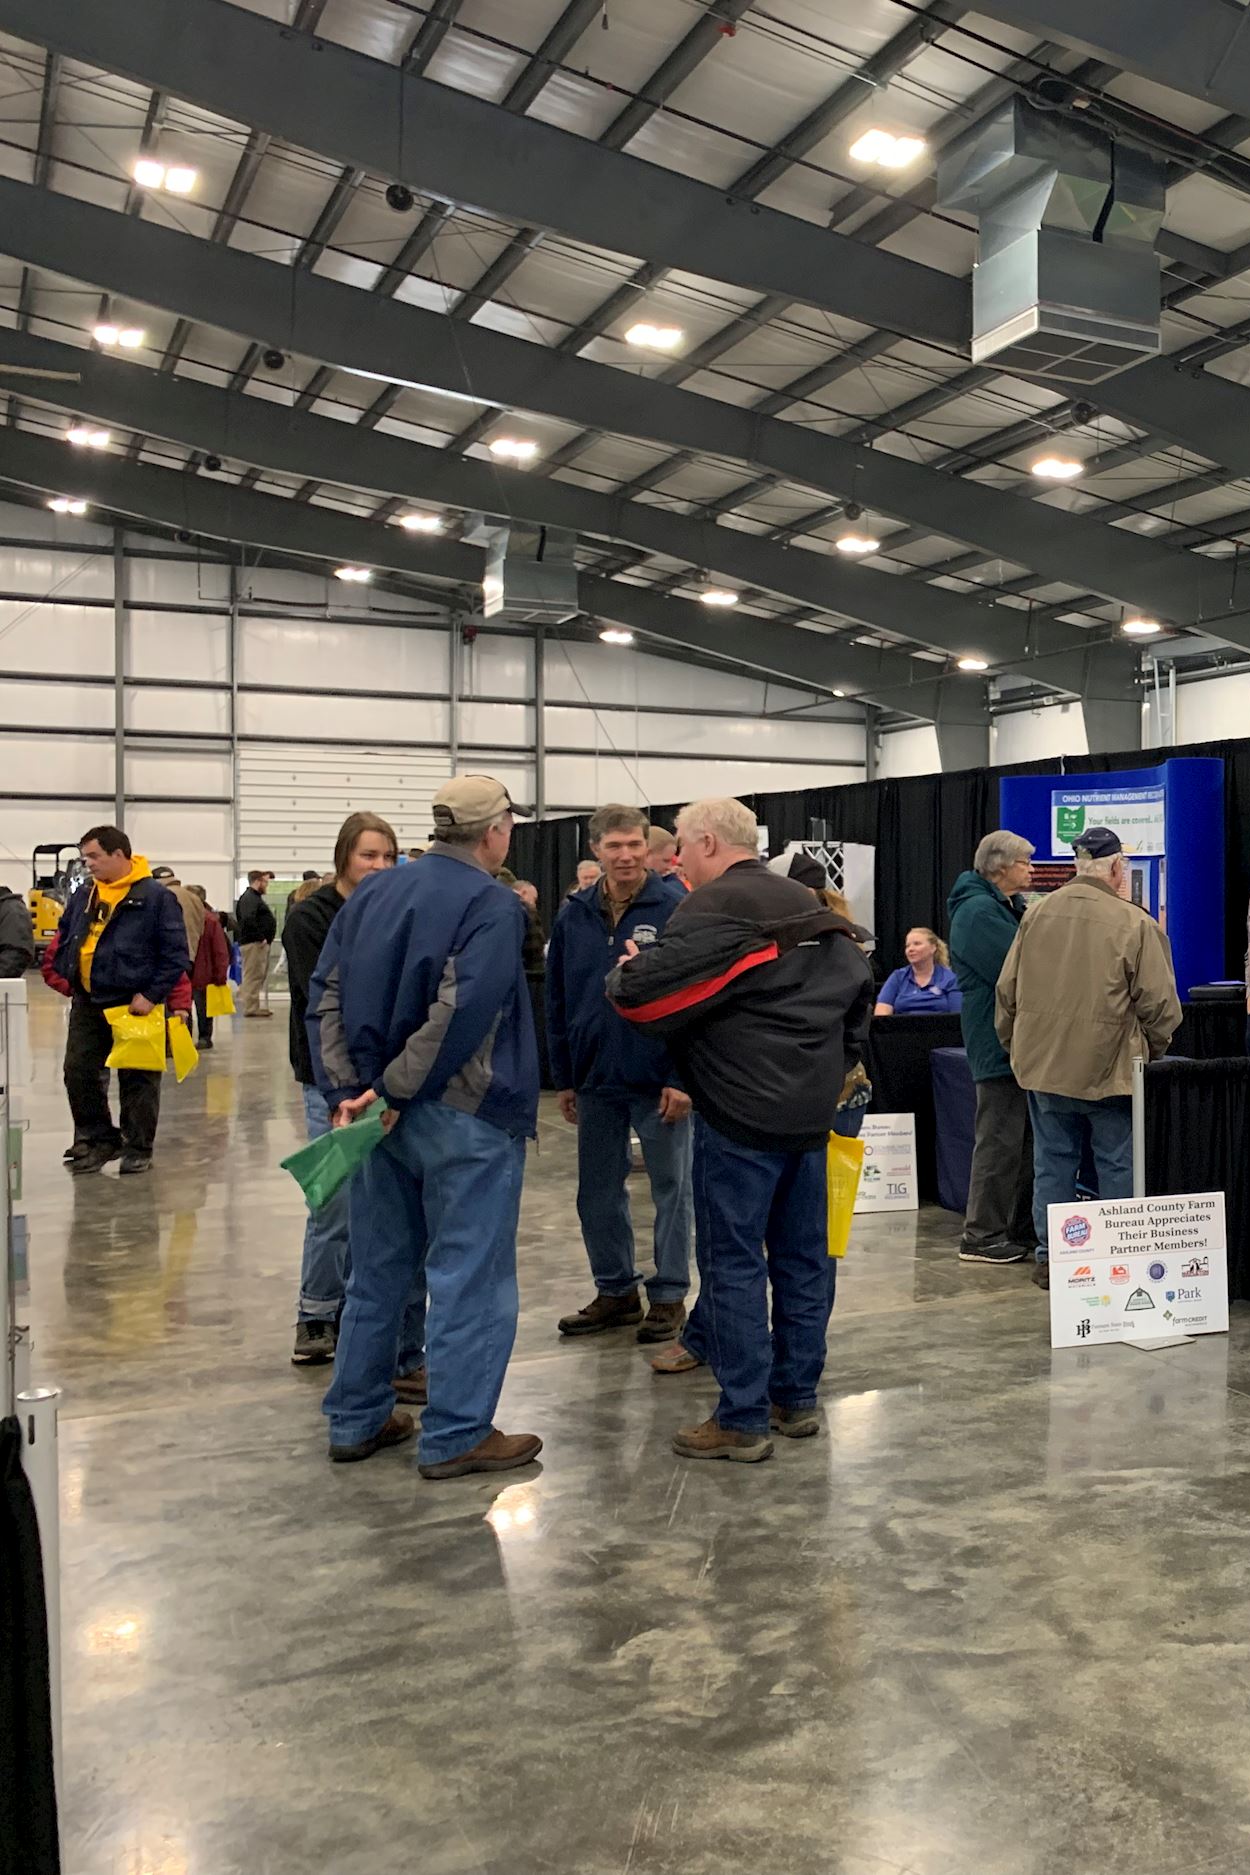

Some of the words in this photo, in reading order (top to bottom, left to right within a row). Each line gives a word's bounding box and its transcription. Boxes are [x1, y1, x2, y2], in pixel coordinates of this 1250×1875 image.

[1062, 794, 1081, 803] OHIO
[1088, 817, 1104, 826] Your
[886, 1183, 907, 1195] TIG
[1098, 1203, 1144, 1217] Ashland
[1147, 1201, 1185, 1214] County
[1188, 1201, 1215, 1210] Farm
[1105, 1217, 1144, 1229] Bureau
[1148, 1214, 1211, 1229] Appreciates
[1118, 1231, 1148, 1241] Their
[1150, 1227, 1199, 1239] Business
[1110, 1243, 1151, 1255] Partner
[1154, 1238, 1208, 1251] Members!
[1177, 1287, 1202, 1299] Park
